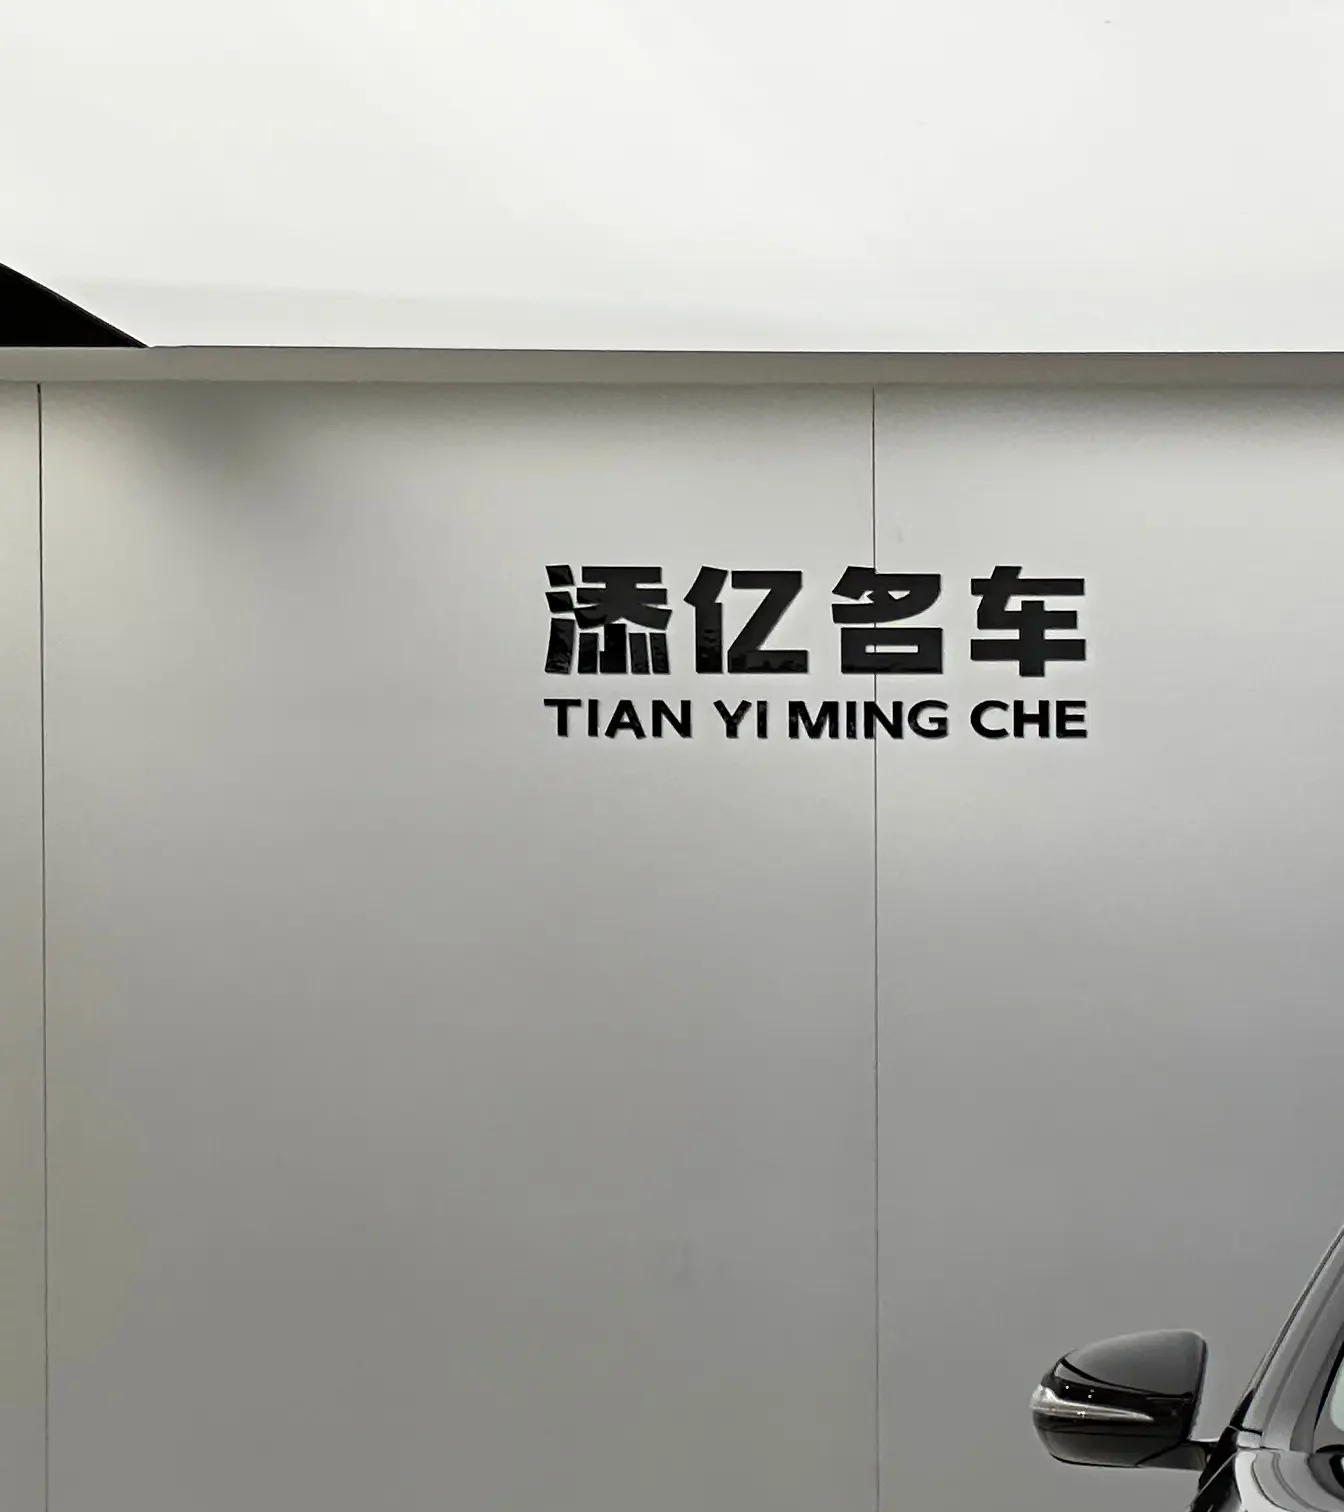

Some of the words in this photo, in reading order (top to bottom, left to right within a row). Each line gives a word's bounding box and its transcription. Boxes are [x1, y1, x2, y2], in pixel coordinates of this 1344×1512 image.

[545, 565, 1086, 677] 添亿名车
[544, 698, 692, 738] TIAN
[713, 700, 768, 739] YI
[788, 700, 949, 740] MING
[969, 700, 1088, 740] CHE
